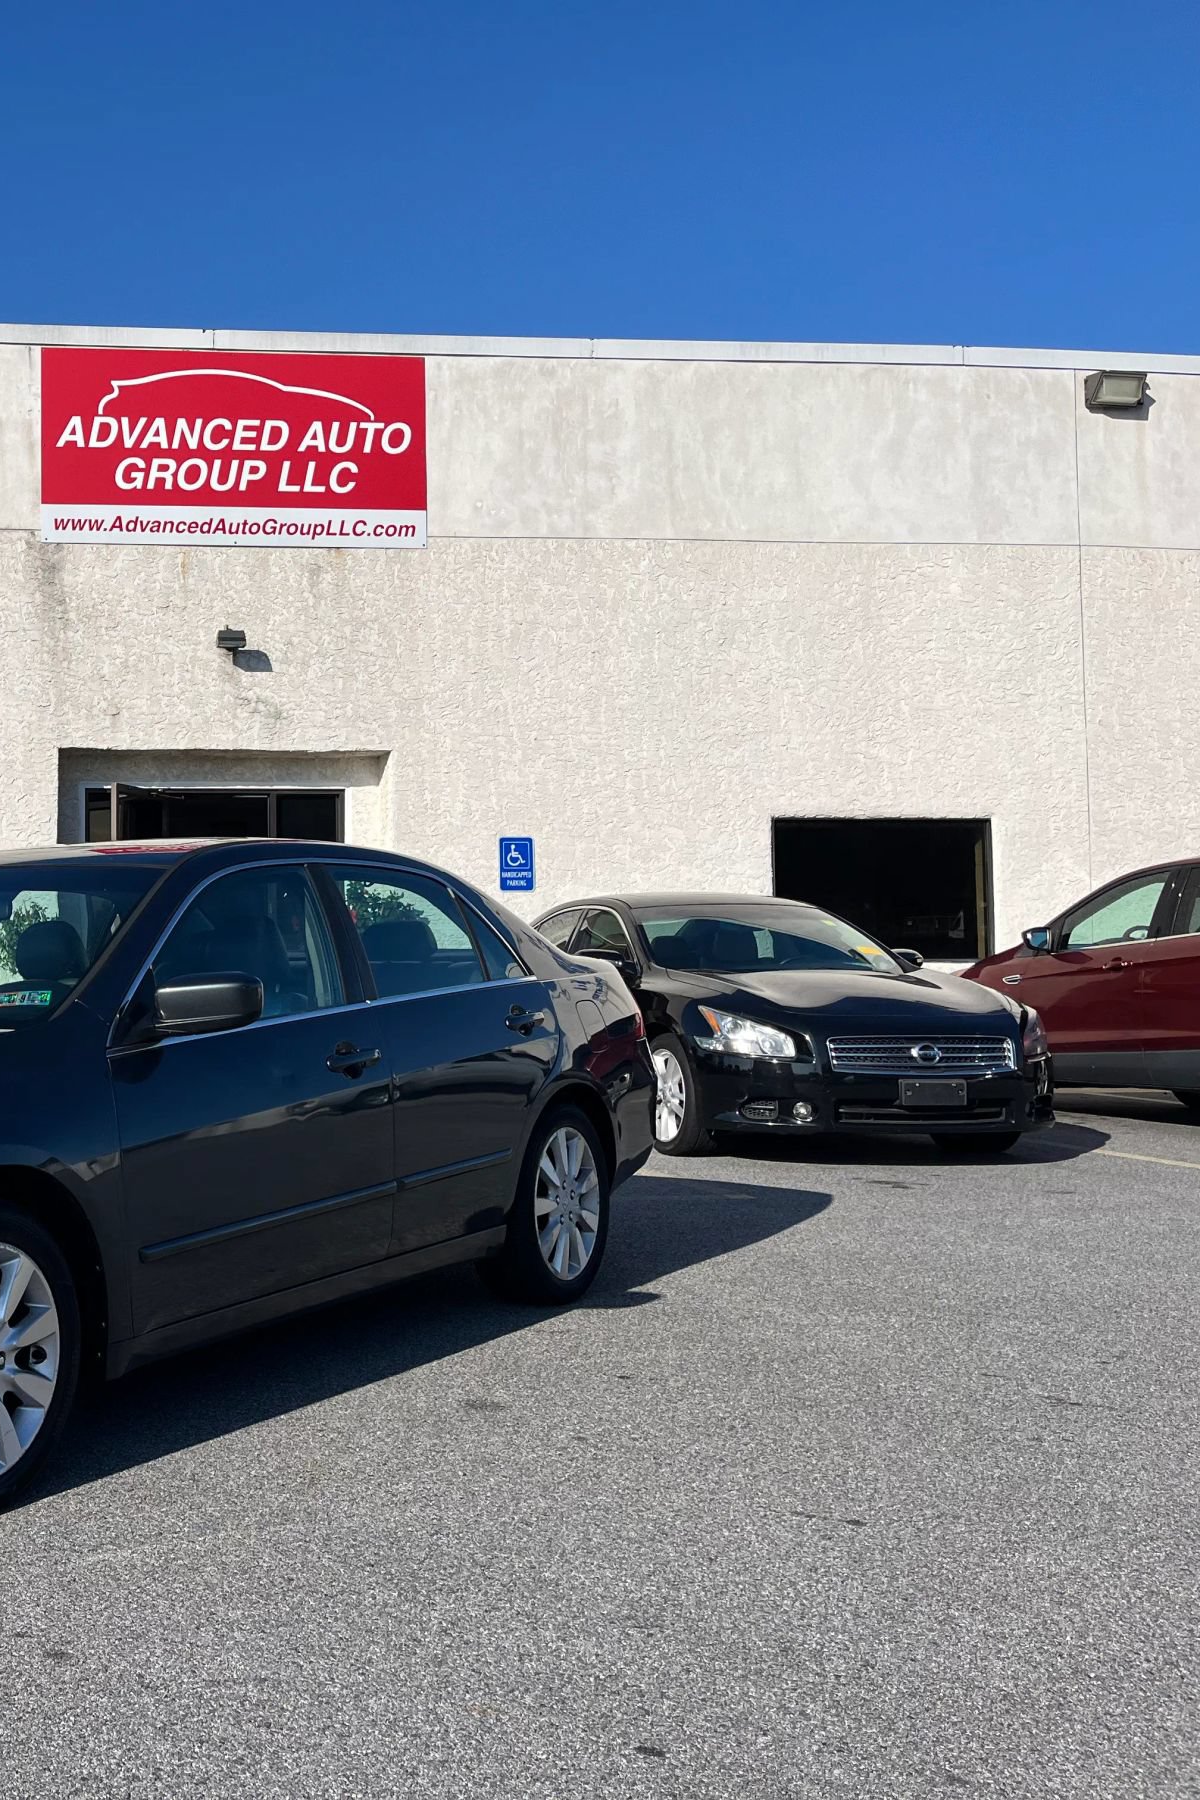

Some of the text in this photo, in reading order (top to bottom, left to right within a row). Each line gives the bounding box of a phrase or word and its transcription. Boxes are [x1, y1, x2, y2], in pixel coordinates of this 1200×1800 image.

[56, 416, 412, 455] ADVANCED AUTO
[115, 458, 359, 494] GROUP LLC
[53, 514, 417, 540] www.AdvancedAutoGroupLLC.com
[501, 871, 532, 879] HANDICAPPED
[506, 879, 527, 887] PARKING
